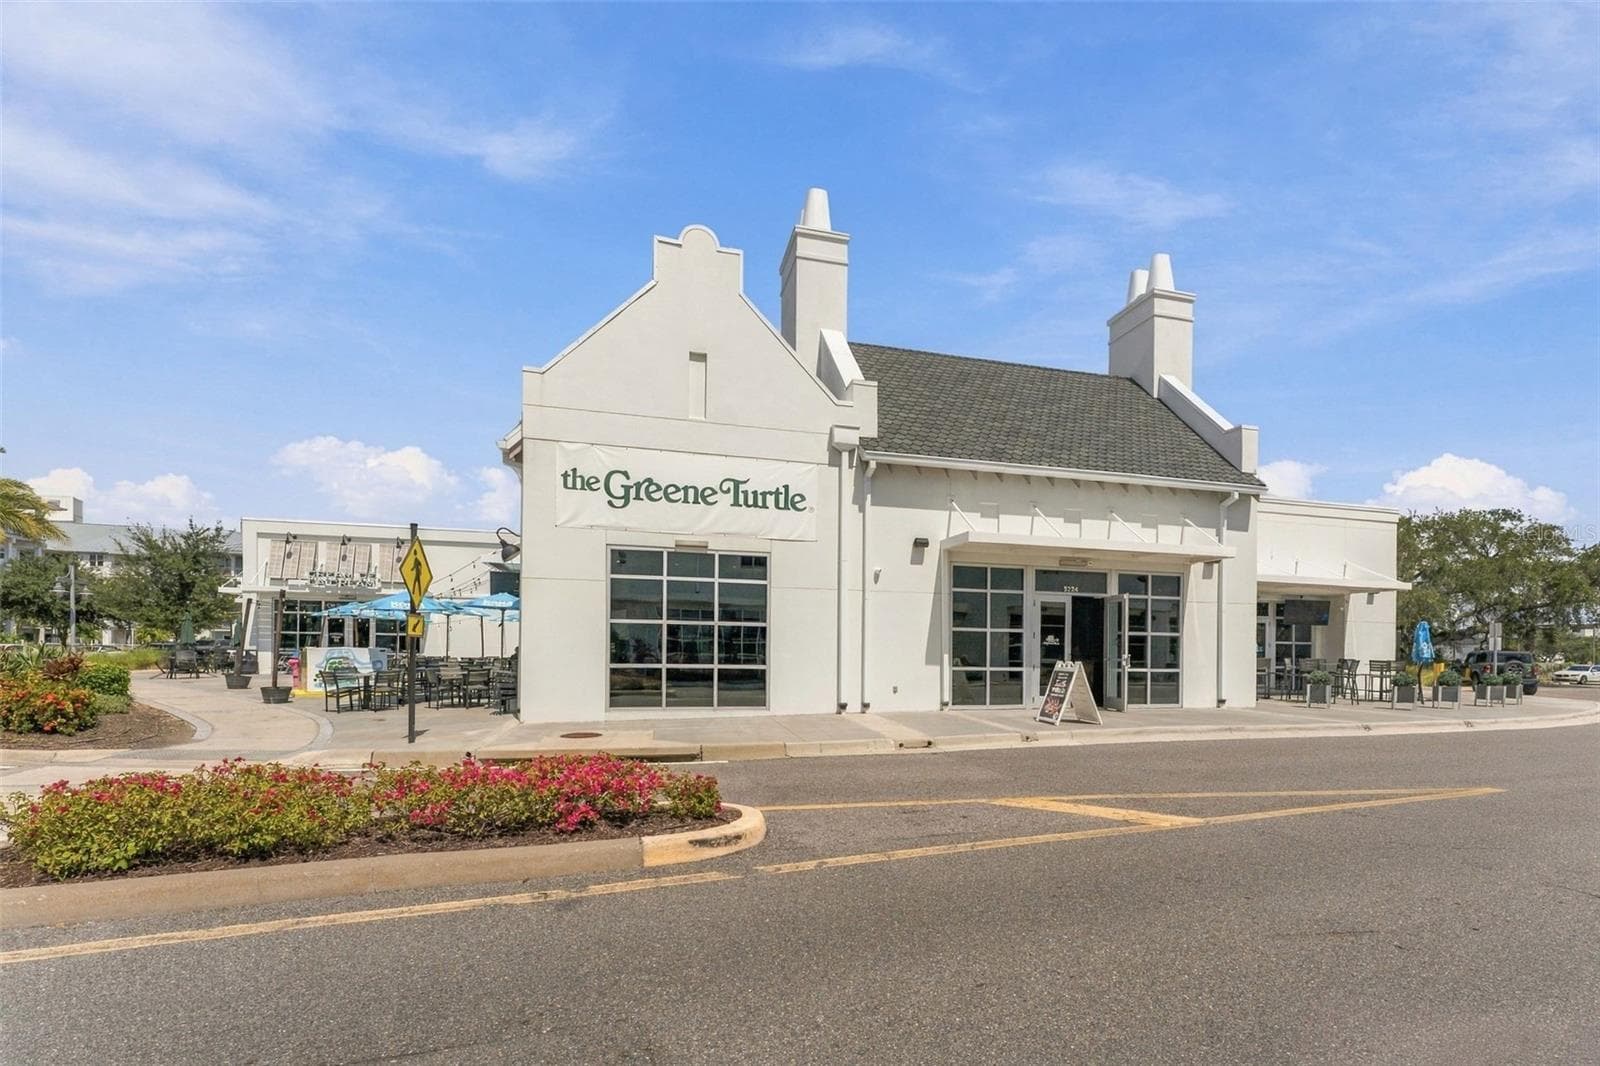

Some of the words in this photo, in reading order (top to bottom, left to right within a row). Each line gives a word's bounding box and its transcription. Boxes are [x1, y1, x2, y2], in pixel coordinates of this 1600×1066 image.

[561, 467, 601, 491] the
[604, 469, 718, 509] Greene
[719, 477, 808, 512] Turtle
